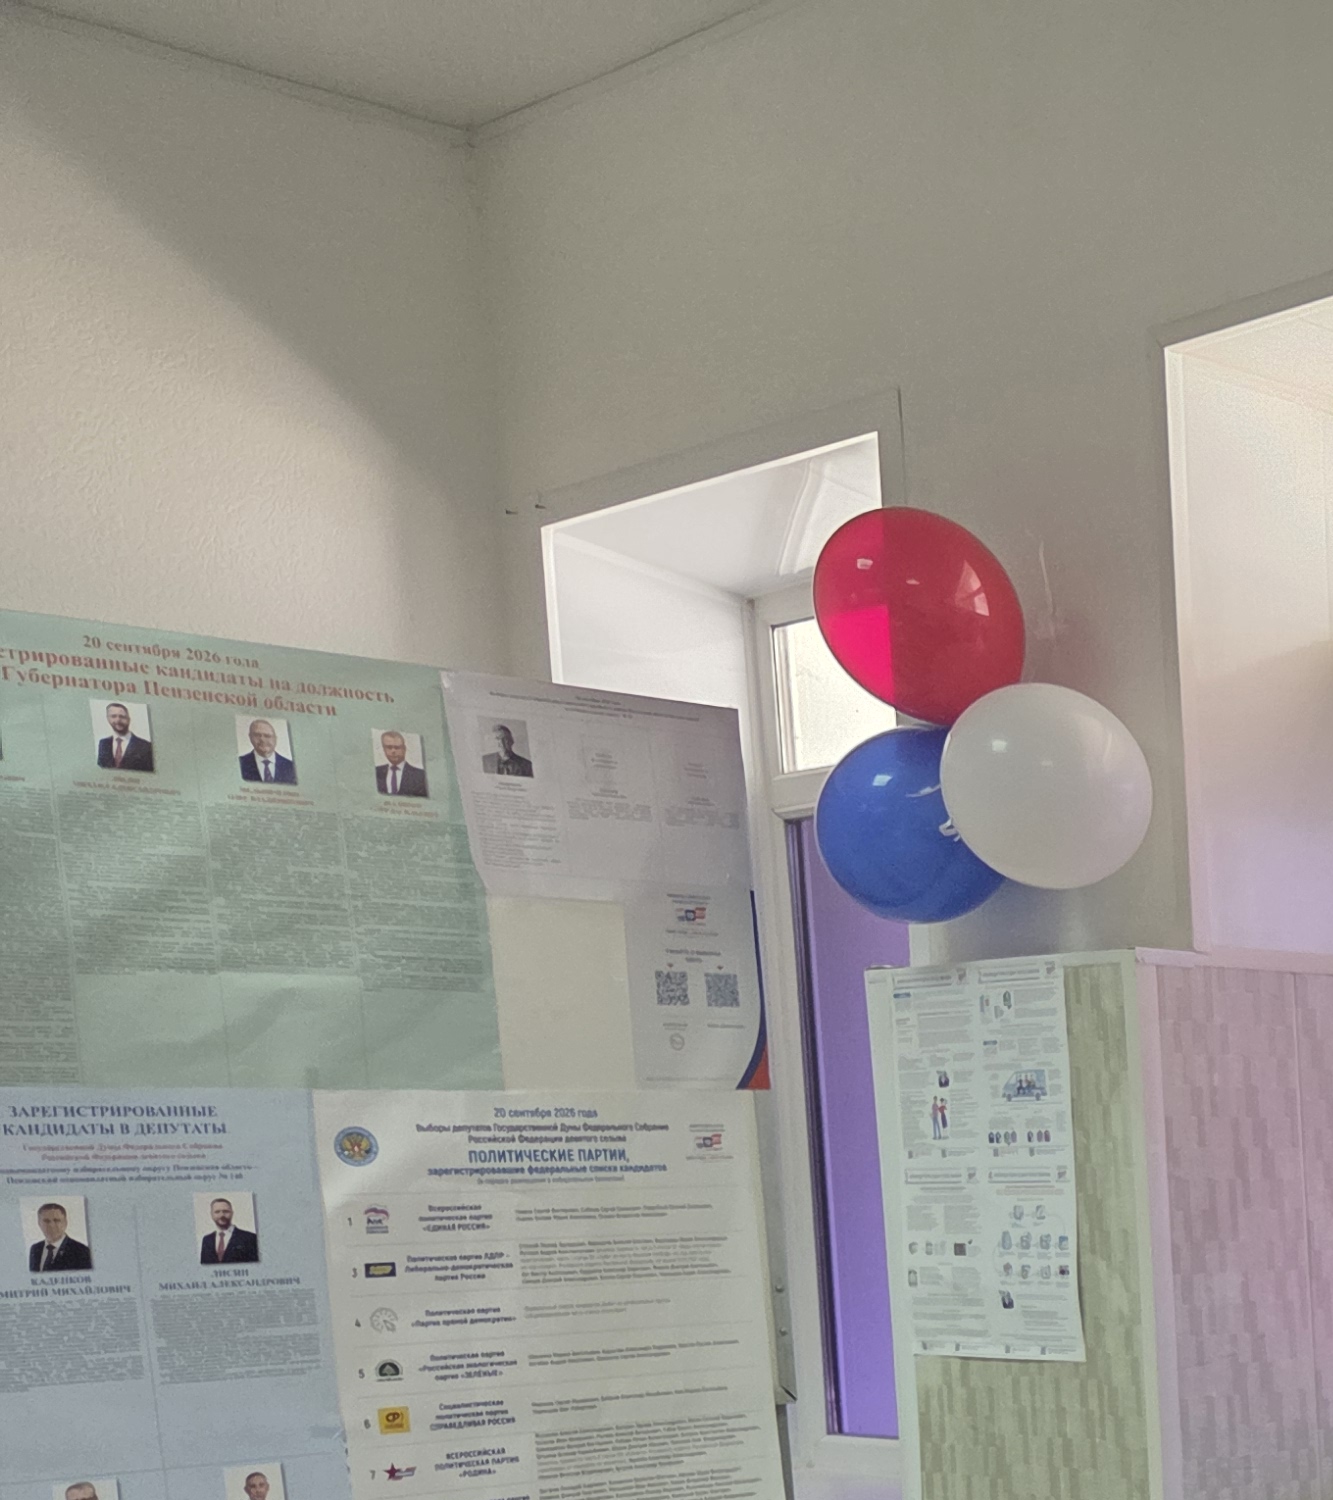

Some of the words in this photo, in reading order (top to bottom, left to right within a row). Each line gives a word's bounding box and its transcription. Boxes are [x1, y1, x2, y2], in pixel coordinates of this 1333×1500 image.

[83, 634, 101, 649] 20
[106, 639, 181, 661] сентября
[185, 647, 221, 664] 2026
[226, 656, 259, 669] года
[154, 662, 263, 690] кандидаты
[269, 678, 292, 692] на
[295, 681, 395, 704] должность
[1, 664, 137, 695] Губернатора
[144, 680, 258, 707] Пензенской
[262, 695, 338, 717] области
[9, 1105, 218, 1119] ЗАРЕГИСТРИРОВАННЫЕ
[493, 1107, 508, 1119] 20
[509, 1108, 552, 1121] сентября
[554, 1107, 576, 1118] 2026
[577, 1107, 598, 1119] года
[3, 1123, 115, 1137] КАНДИДАТЫ
[120, 1123, 130, 1135] В
[134, 1123, 227, 1136] ДЕПУТАТЫ
[468, 1149, 575, 1164] ПОЛИТИЧЕСКИЕ
[577, 1149, 630, 1163] ПАРТИИ,
[347, 1217, 353, 1226] 1
[352, 1267, 358, 1278] 3
[52, 1286, 132, 1297] МИХАЙЛОВИЧ
[355, 1319, 361, 1328] 4
[358, 1370, 365, 1379] 5
[364, 1419, 371, 1429] 6
[370, 1470, 376, 1480] 7
